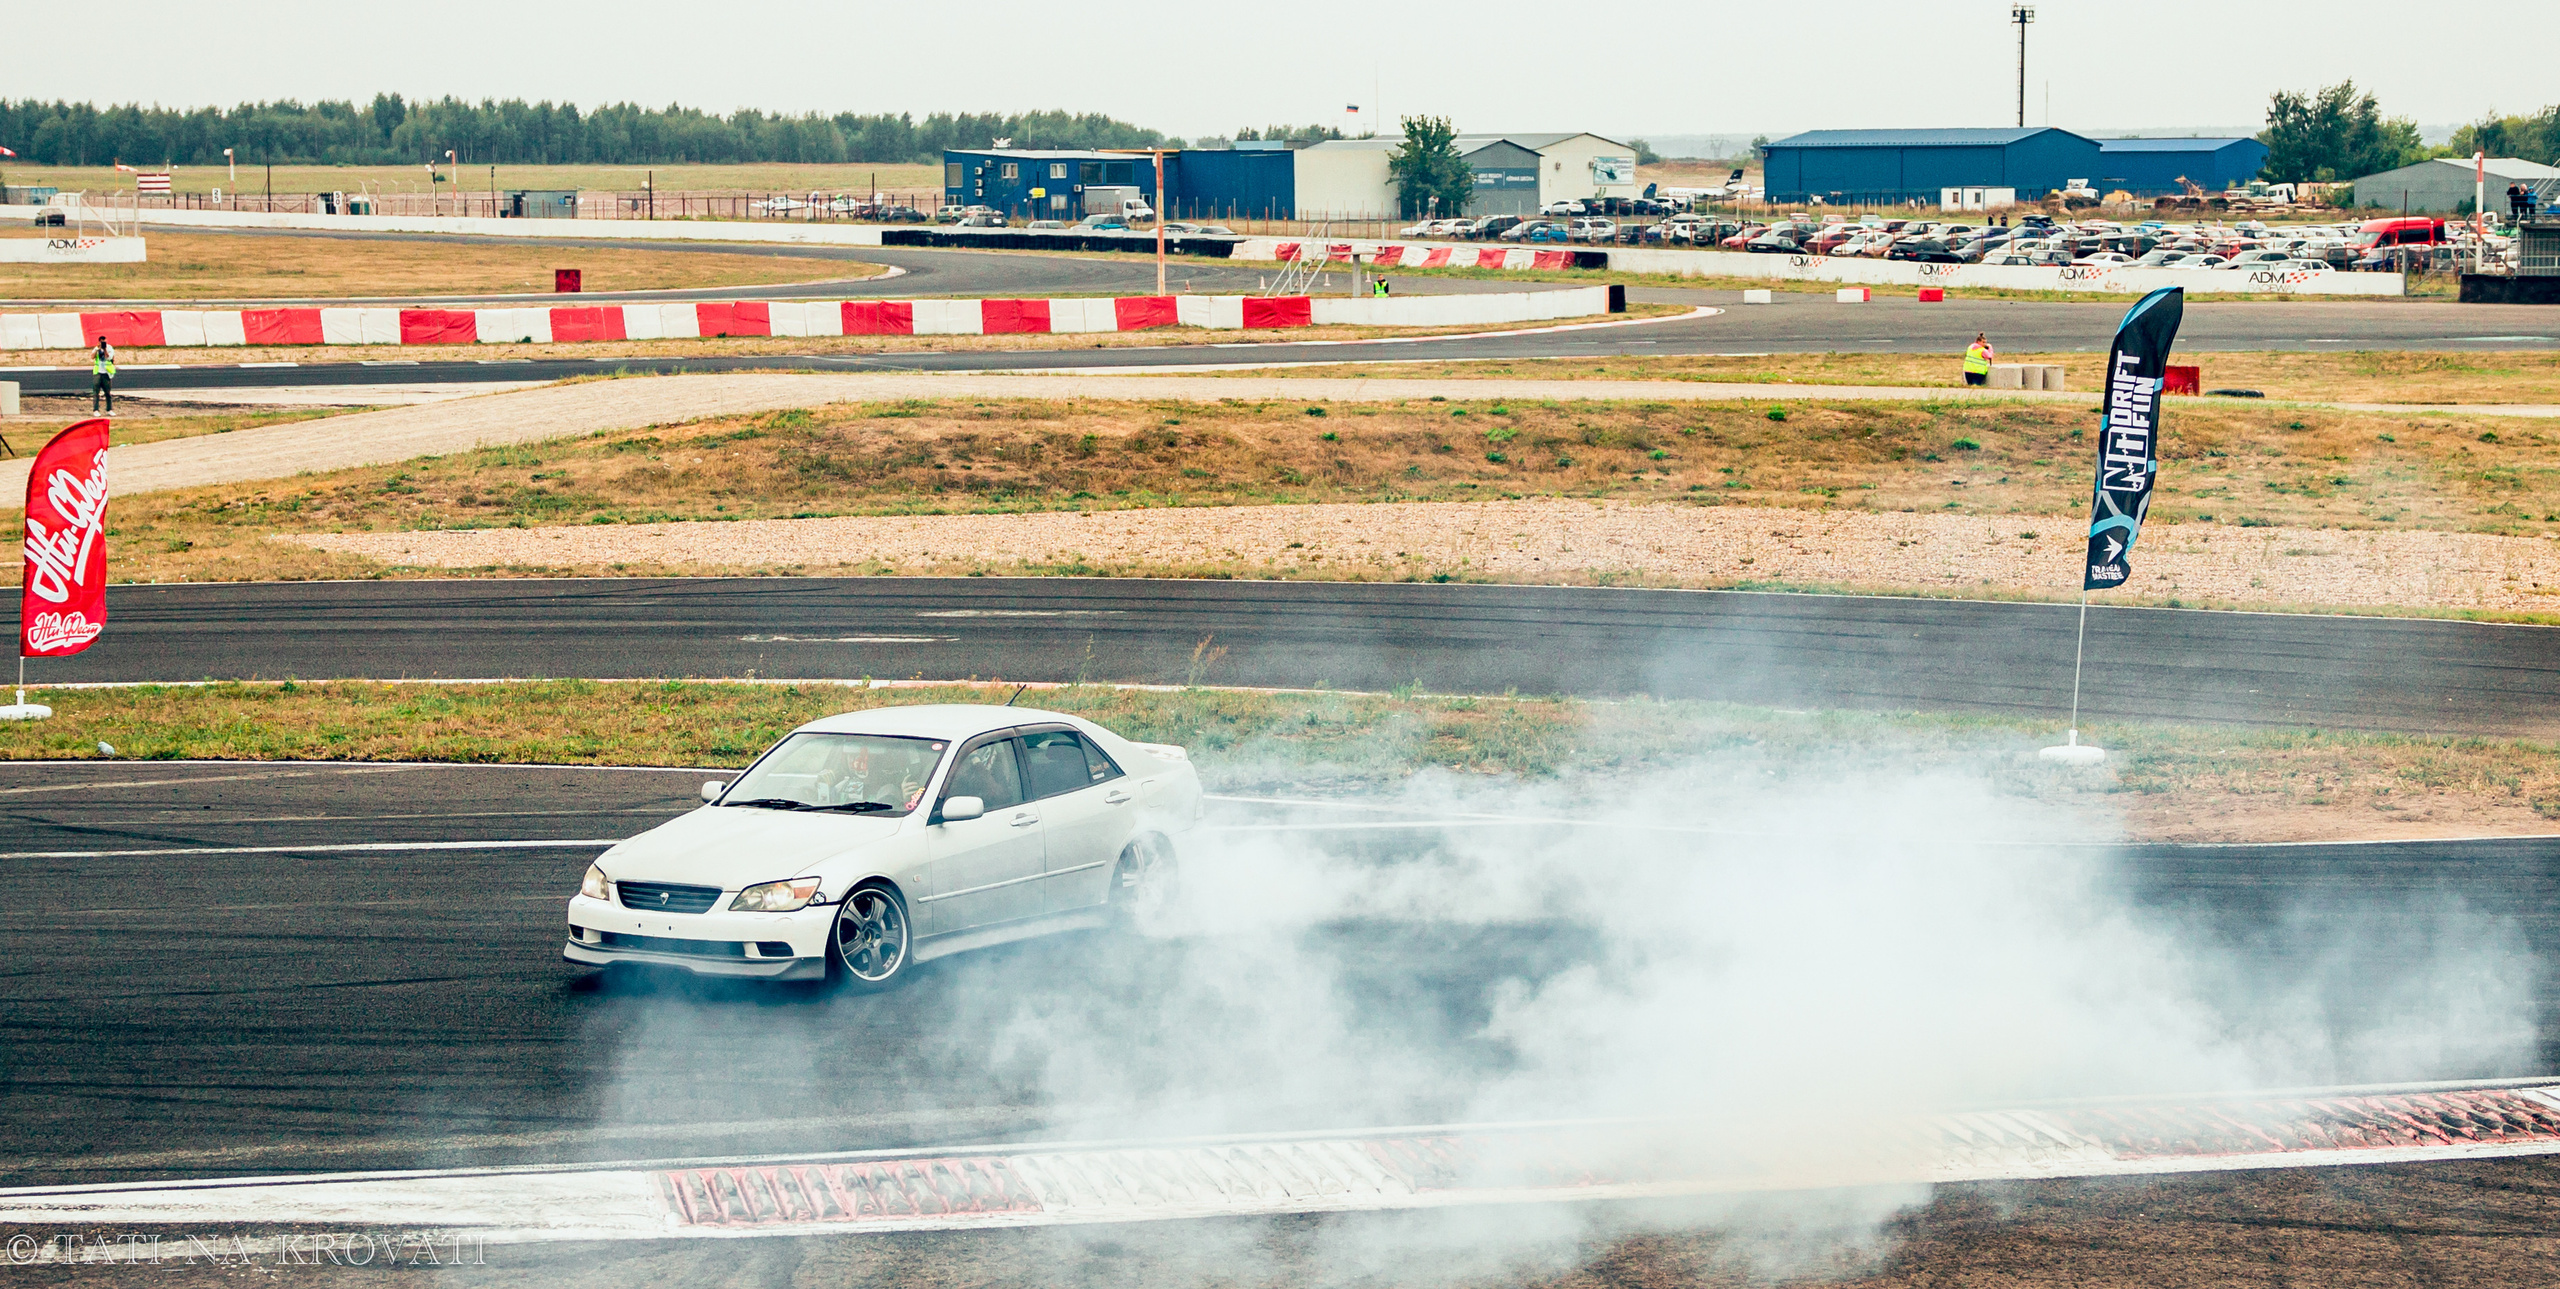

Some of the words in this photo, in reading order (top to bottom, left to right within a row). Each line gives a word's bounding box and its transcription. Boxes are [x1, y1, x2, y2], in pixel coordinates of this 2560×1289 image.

[47, 239, 77, 249] ADM
[1789, 255, 1809, 267] ADM
[1918, 264, 1939, 275] ADM
[2058, 268, 2085, 280] ADM
[2248, 272, 2285, 284] ADM
[2247, 284, 2298, 294] RACEWAY
[2109, 350, 2140, 427] DRIFT
[2132, 376, 2156, 428] FUN
